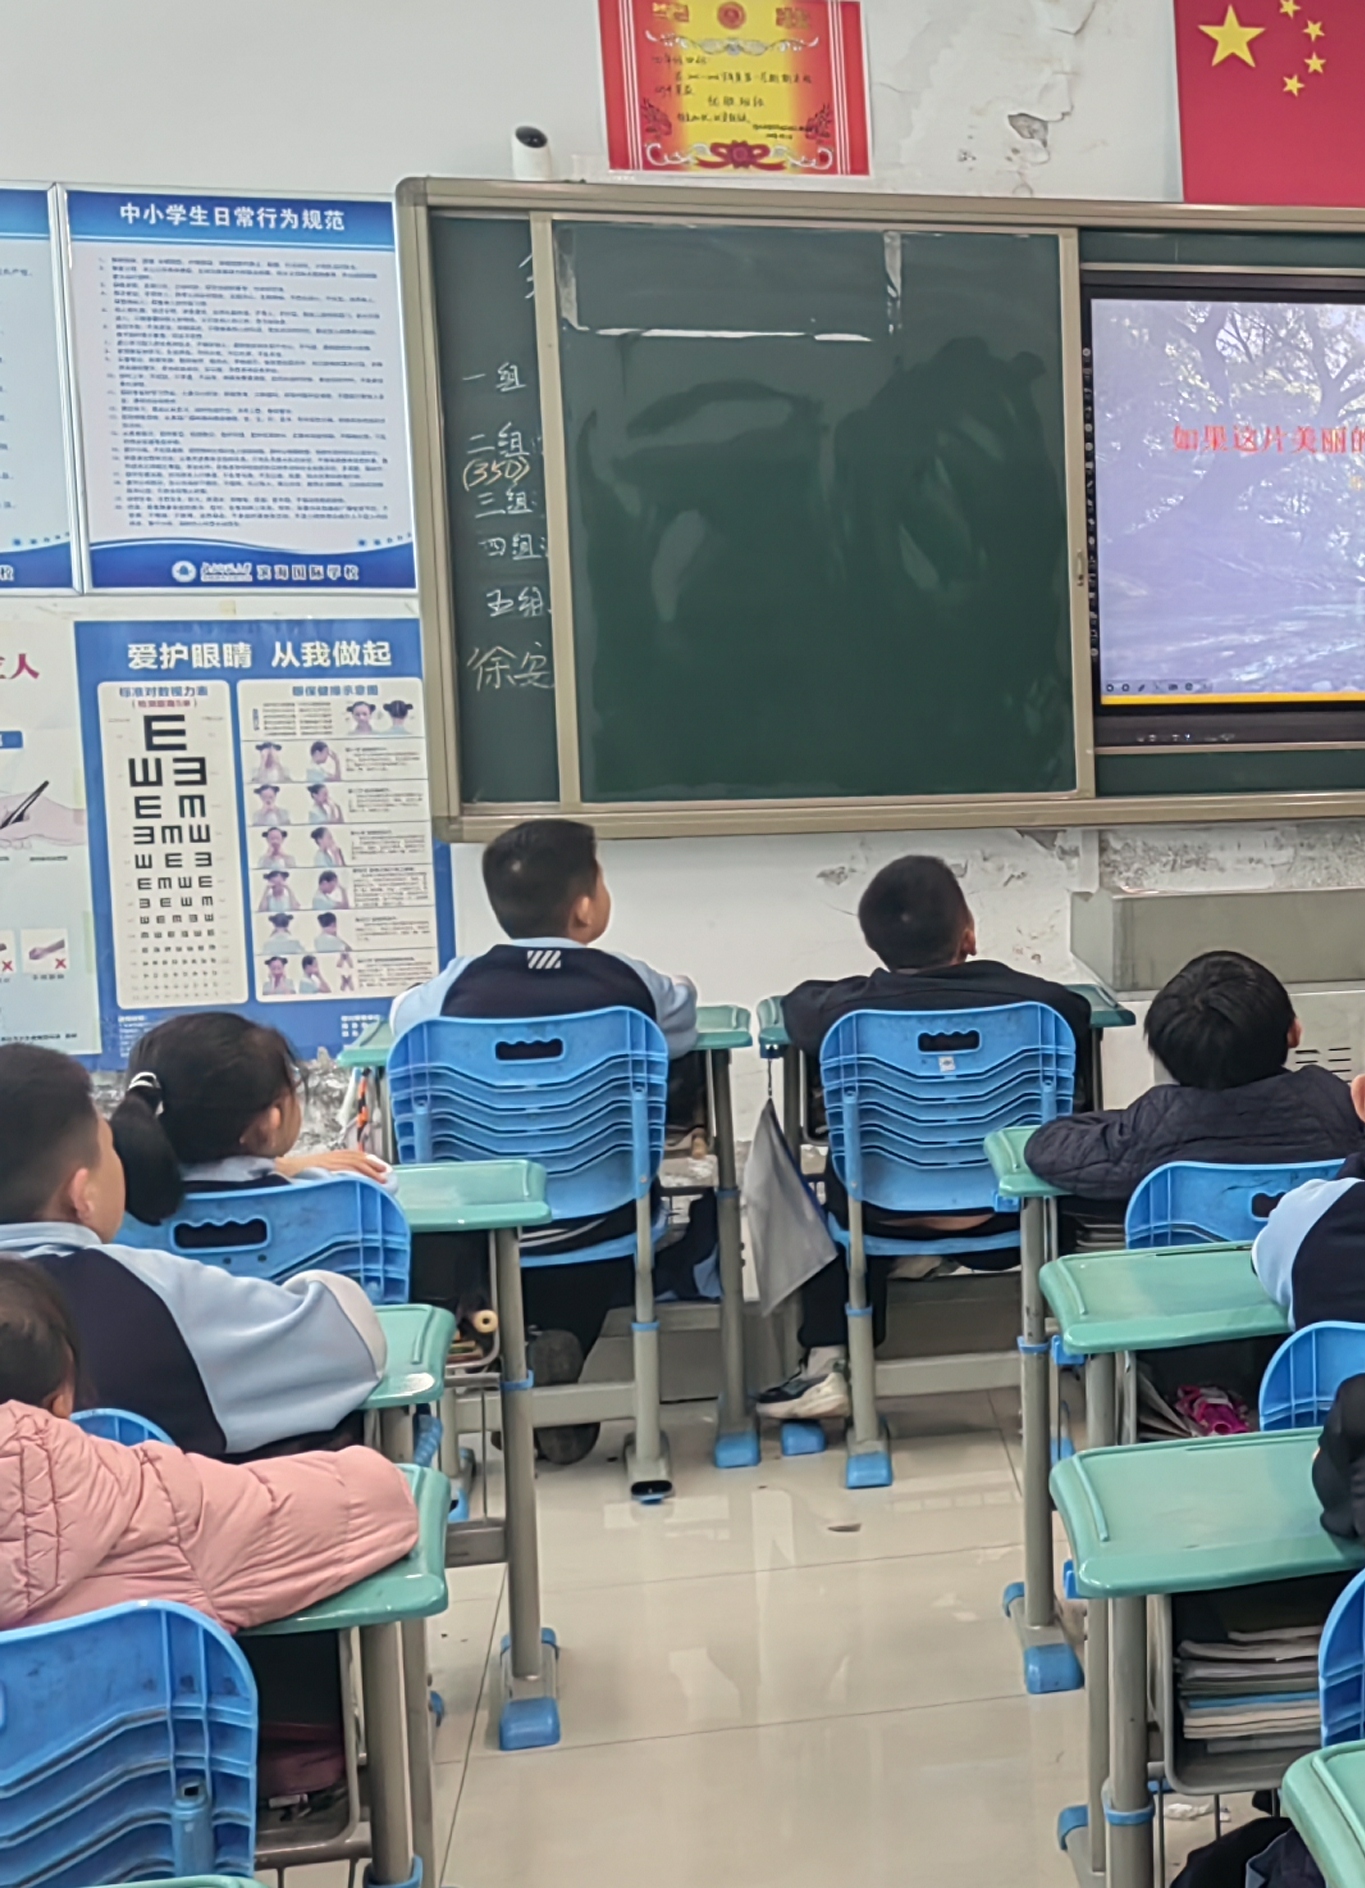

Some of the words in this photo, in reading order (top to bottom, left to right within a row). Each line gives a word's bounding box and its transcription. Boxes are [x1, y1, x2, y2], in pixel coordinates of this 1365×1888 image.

[120, 203, 345, 231] 中小学生日常行为规范
[462, 362, 527, 392] 一组
[467, 421, 530, 458] 二组
[486, 586, 543, 617] 五组
[128, 643, 252, 669] 爱护眼睛
[271, 641, 392, 668] 从我做起
